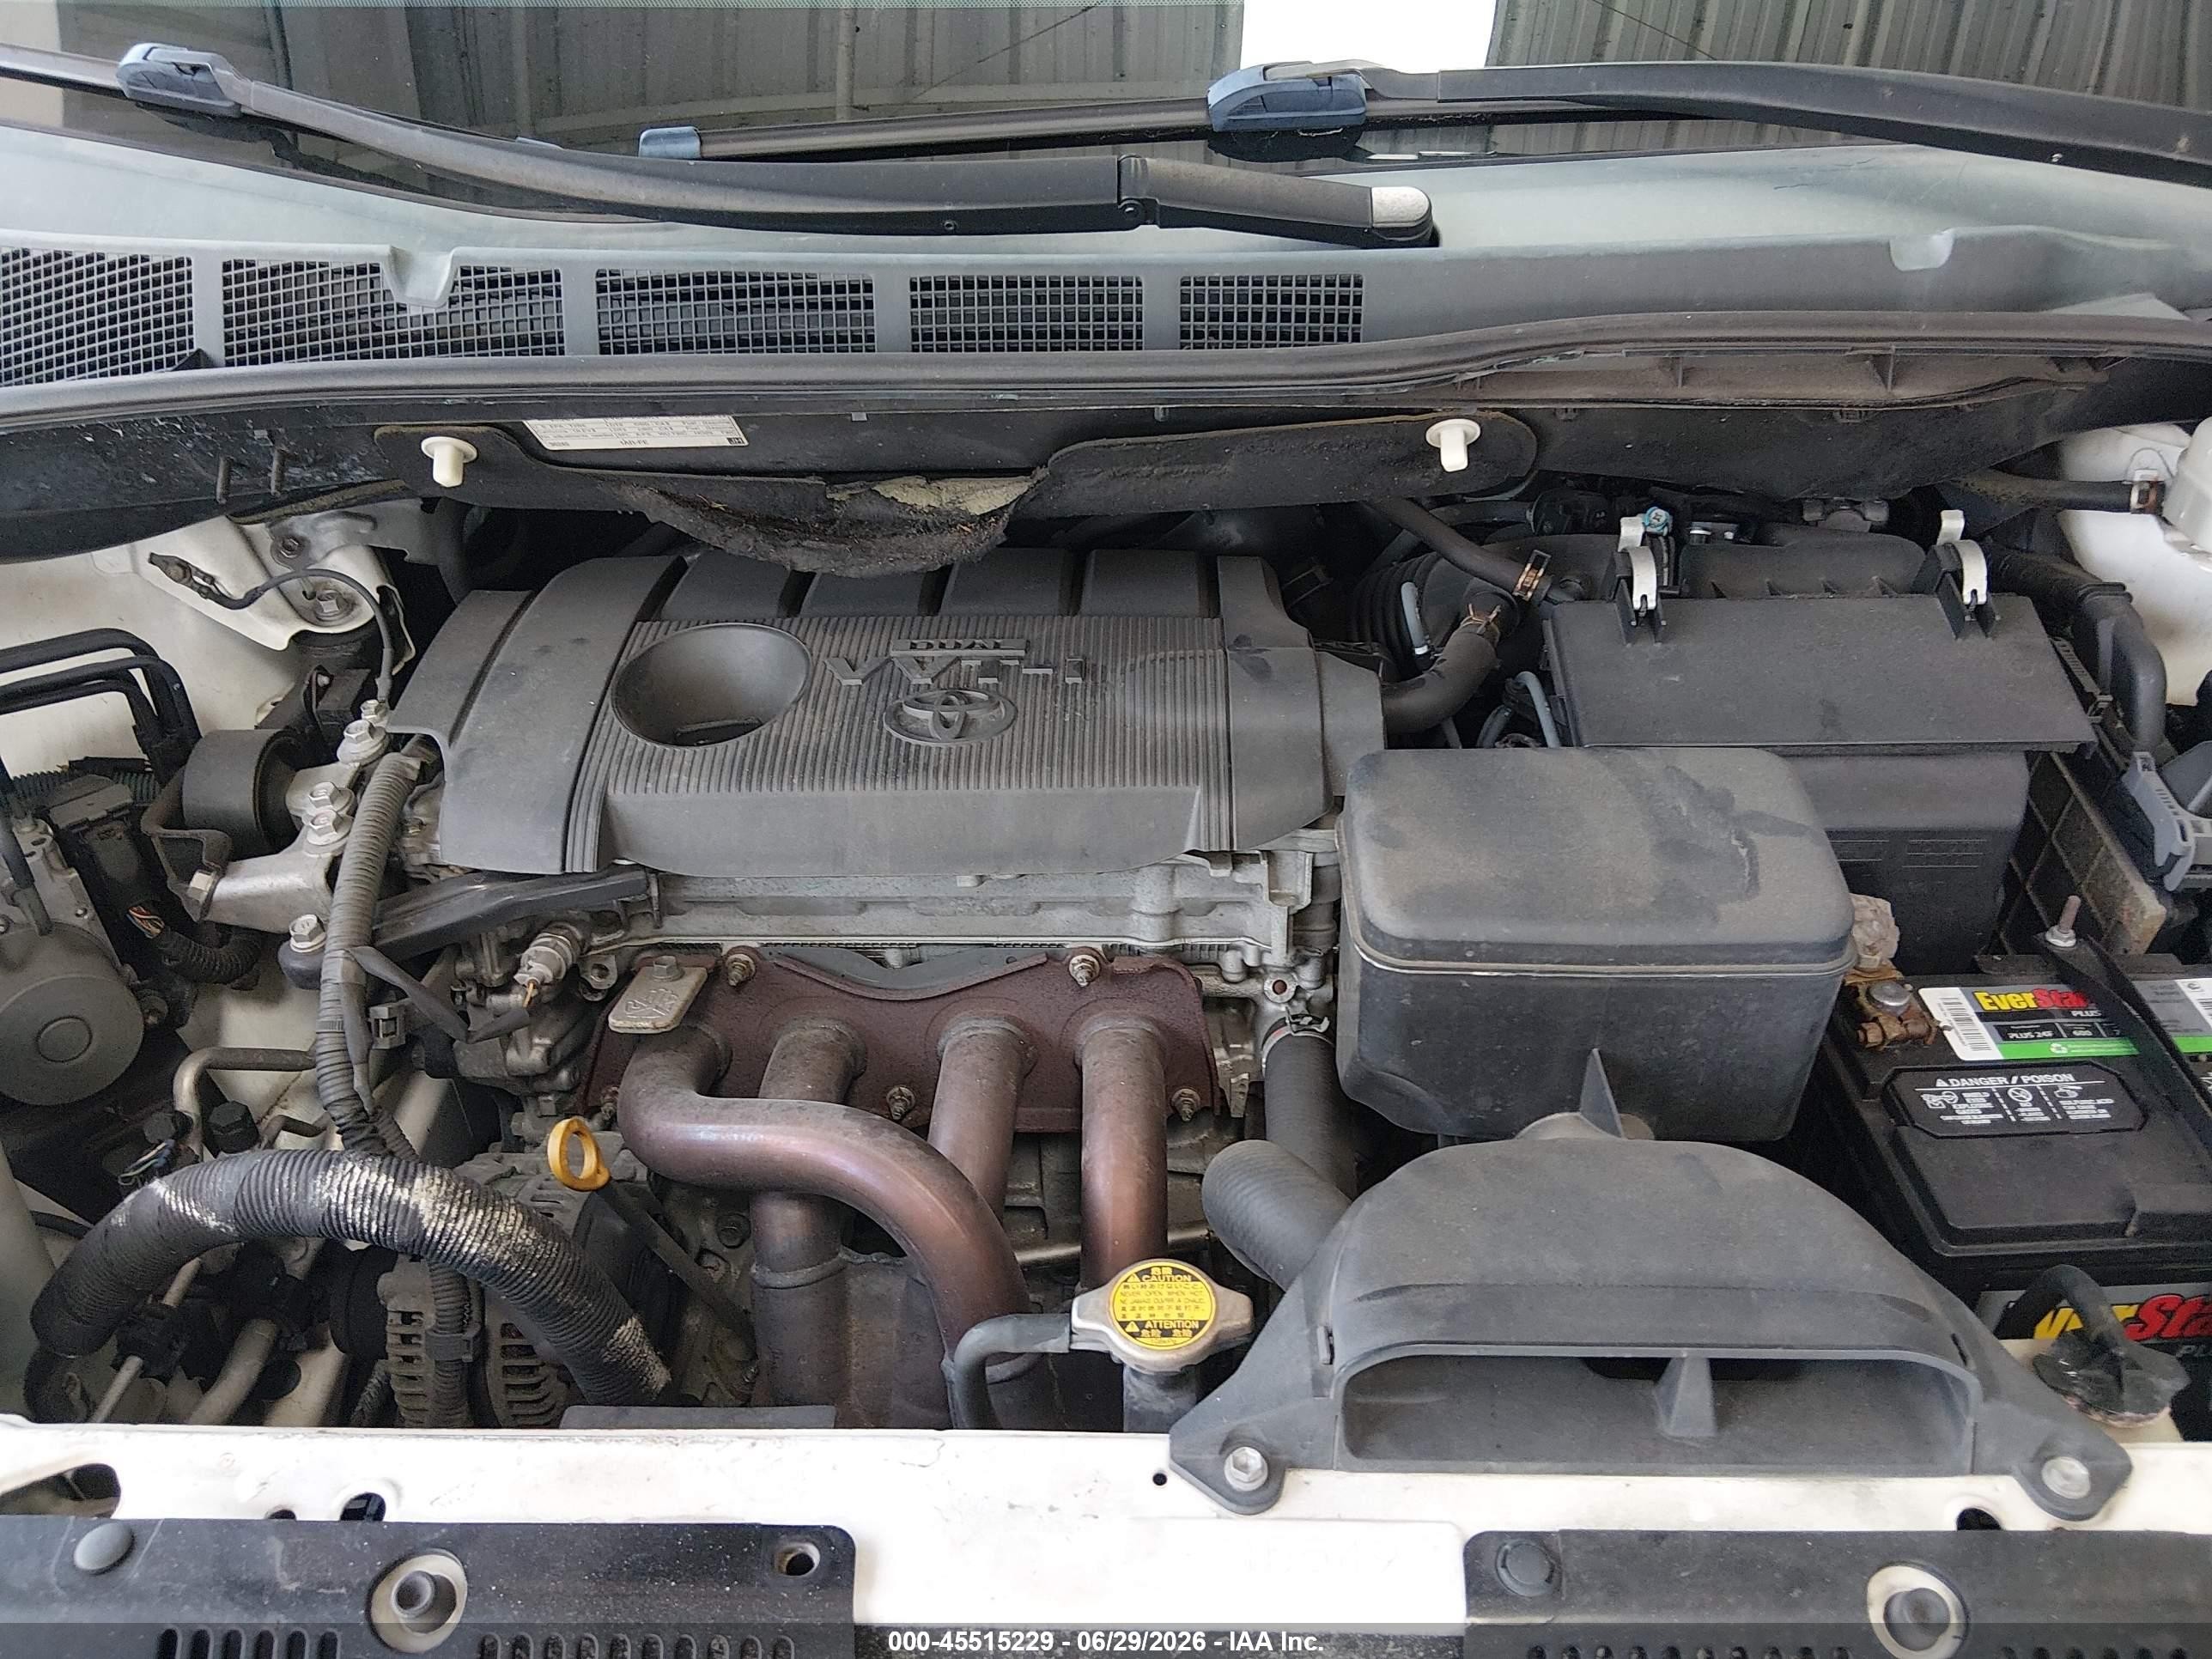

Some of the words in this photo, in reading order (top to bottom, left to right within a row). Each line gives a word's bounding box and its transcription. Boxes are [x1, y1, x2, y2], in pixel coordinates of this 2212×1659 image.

[1948, 1076, 2009, 1087] DANGER
[2021, 1073, 2075, 1085] POISON
[1141, 1274, 1192, 1283] CAUTION
[1145, 1320, 1200, 1329] ATTENTION
